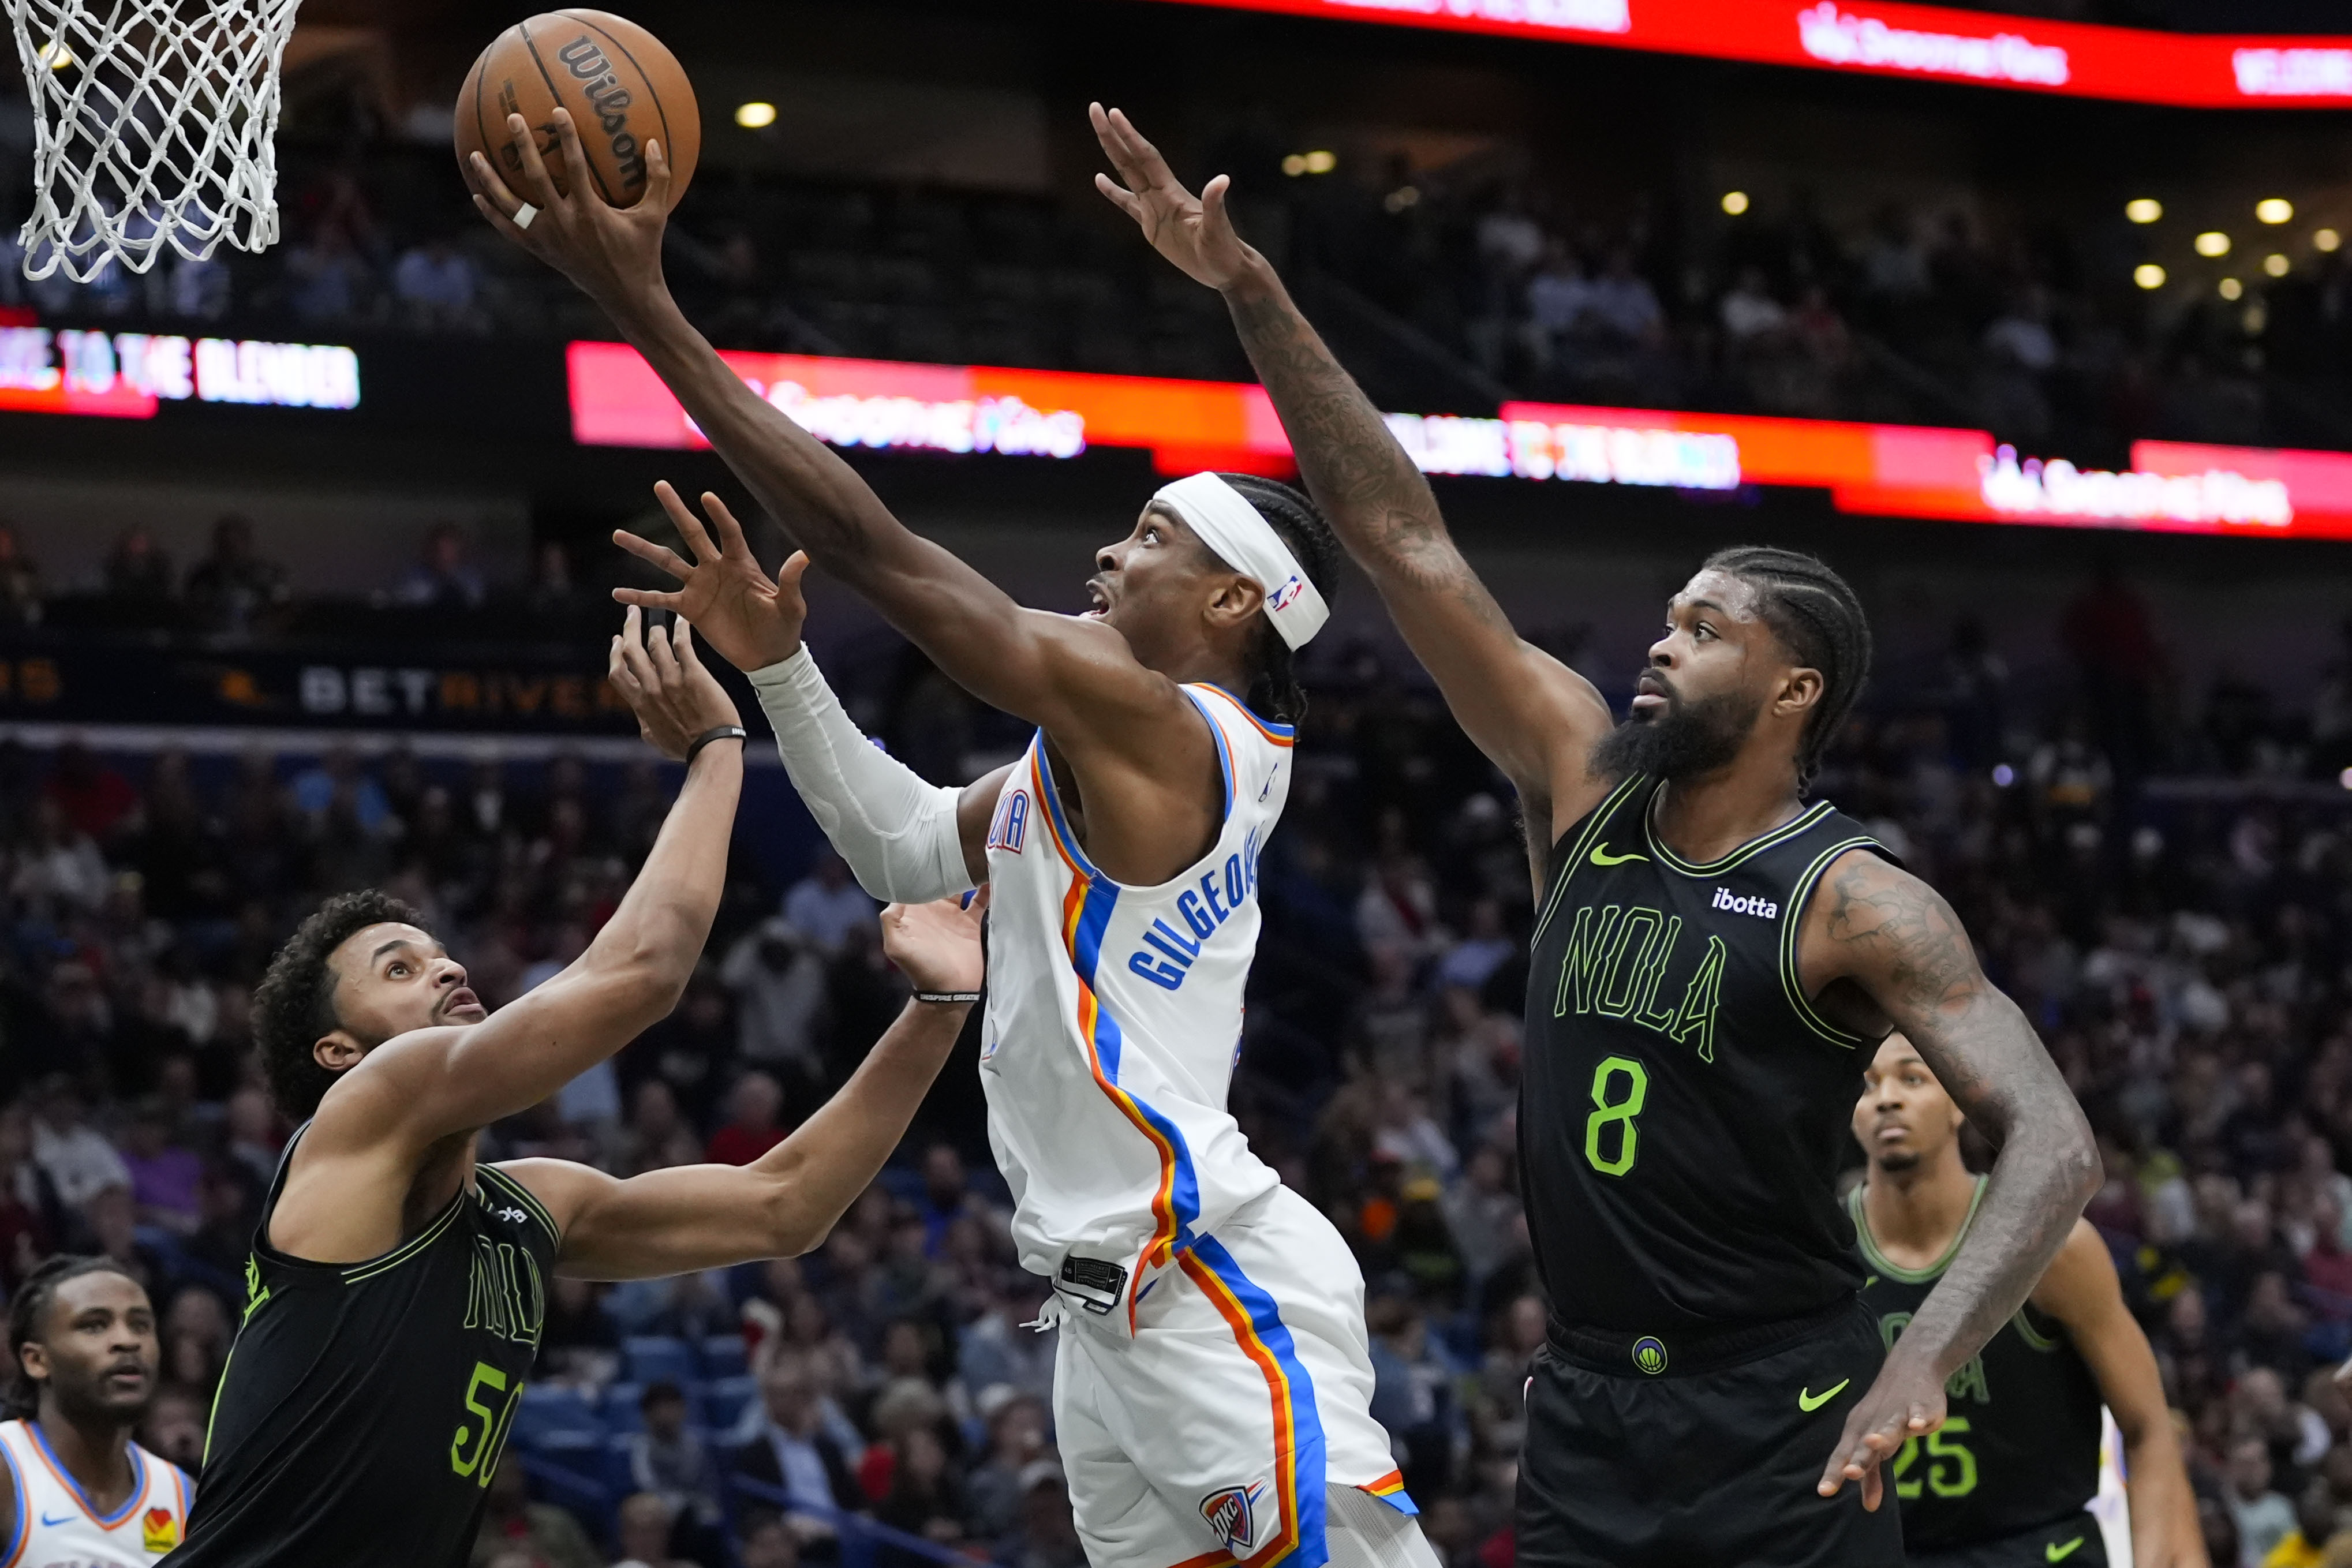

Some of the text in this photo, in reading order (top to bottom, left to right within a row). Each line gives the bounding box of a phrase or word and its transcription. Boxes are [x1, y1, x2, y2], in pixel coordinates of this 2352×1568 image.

[559, 34, 648, 192] Wilson
[1712, 886, 1778, 919] ibotta
[1554, 905, 1726, 1064] NOLA
[1585, 1055, 1650, 1178] 8
[1212, 1496, 1239, 1545] OKC
